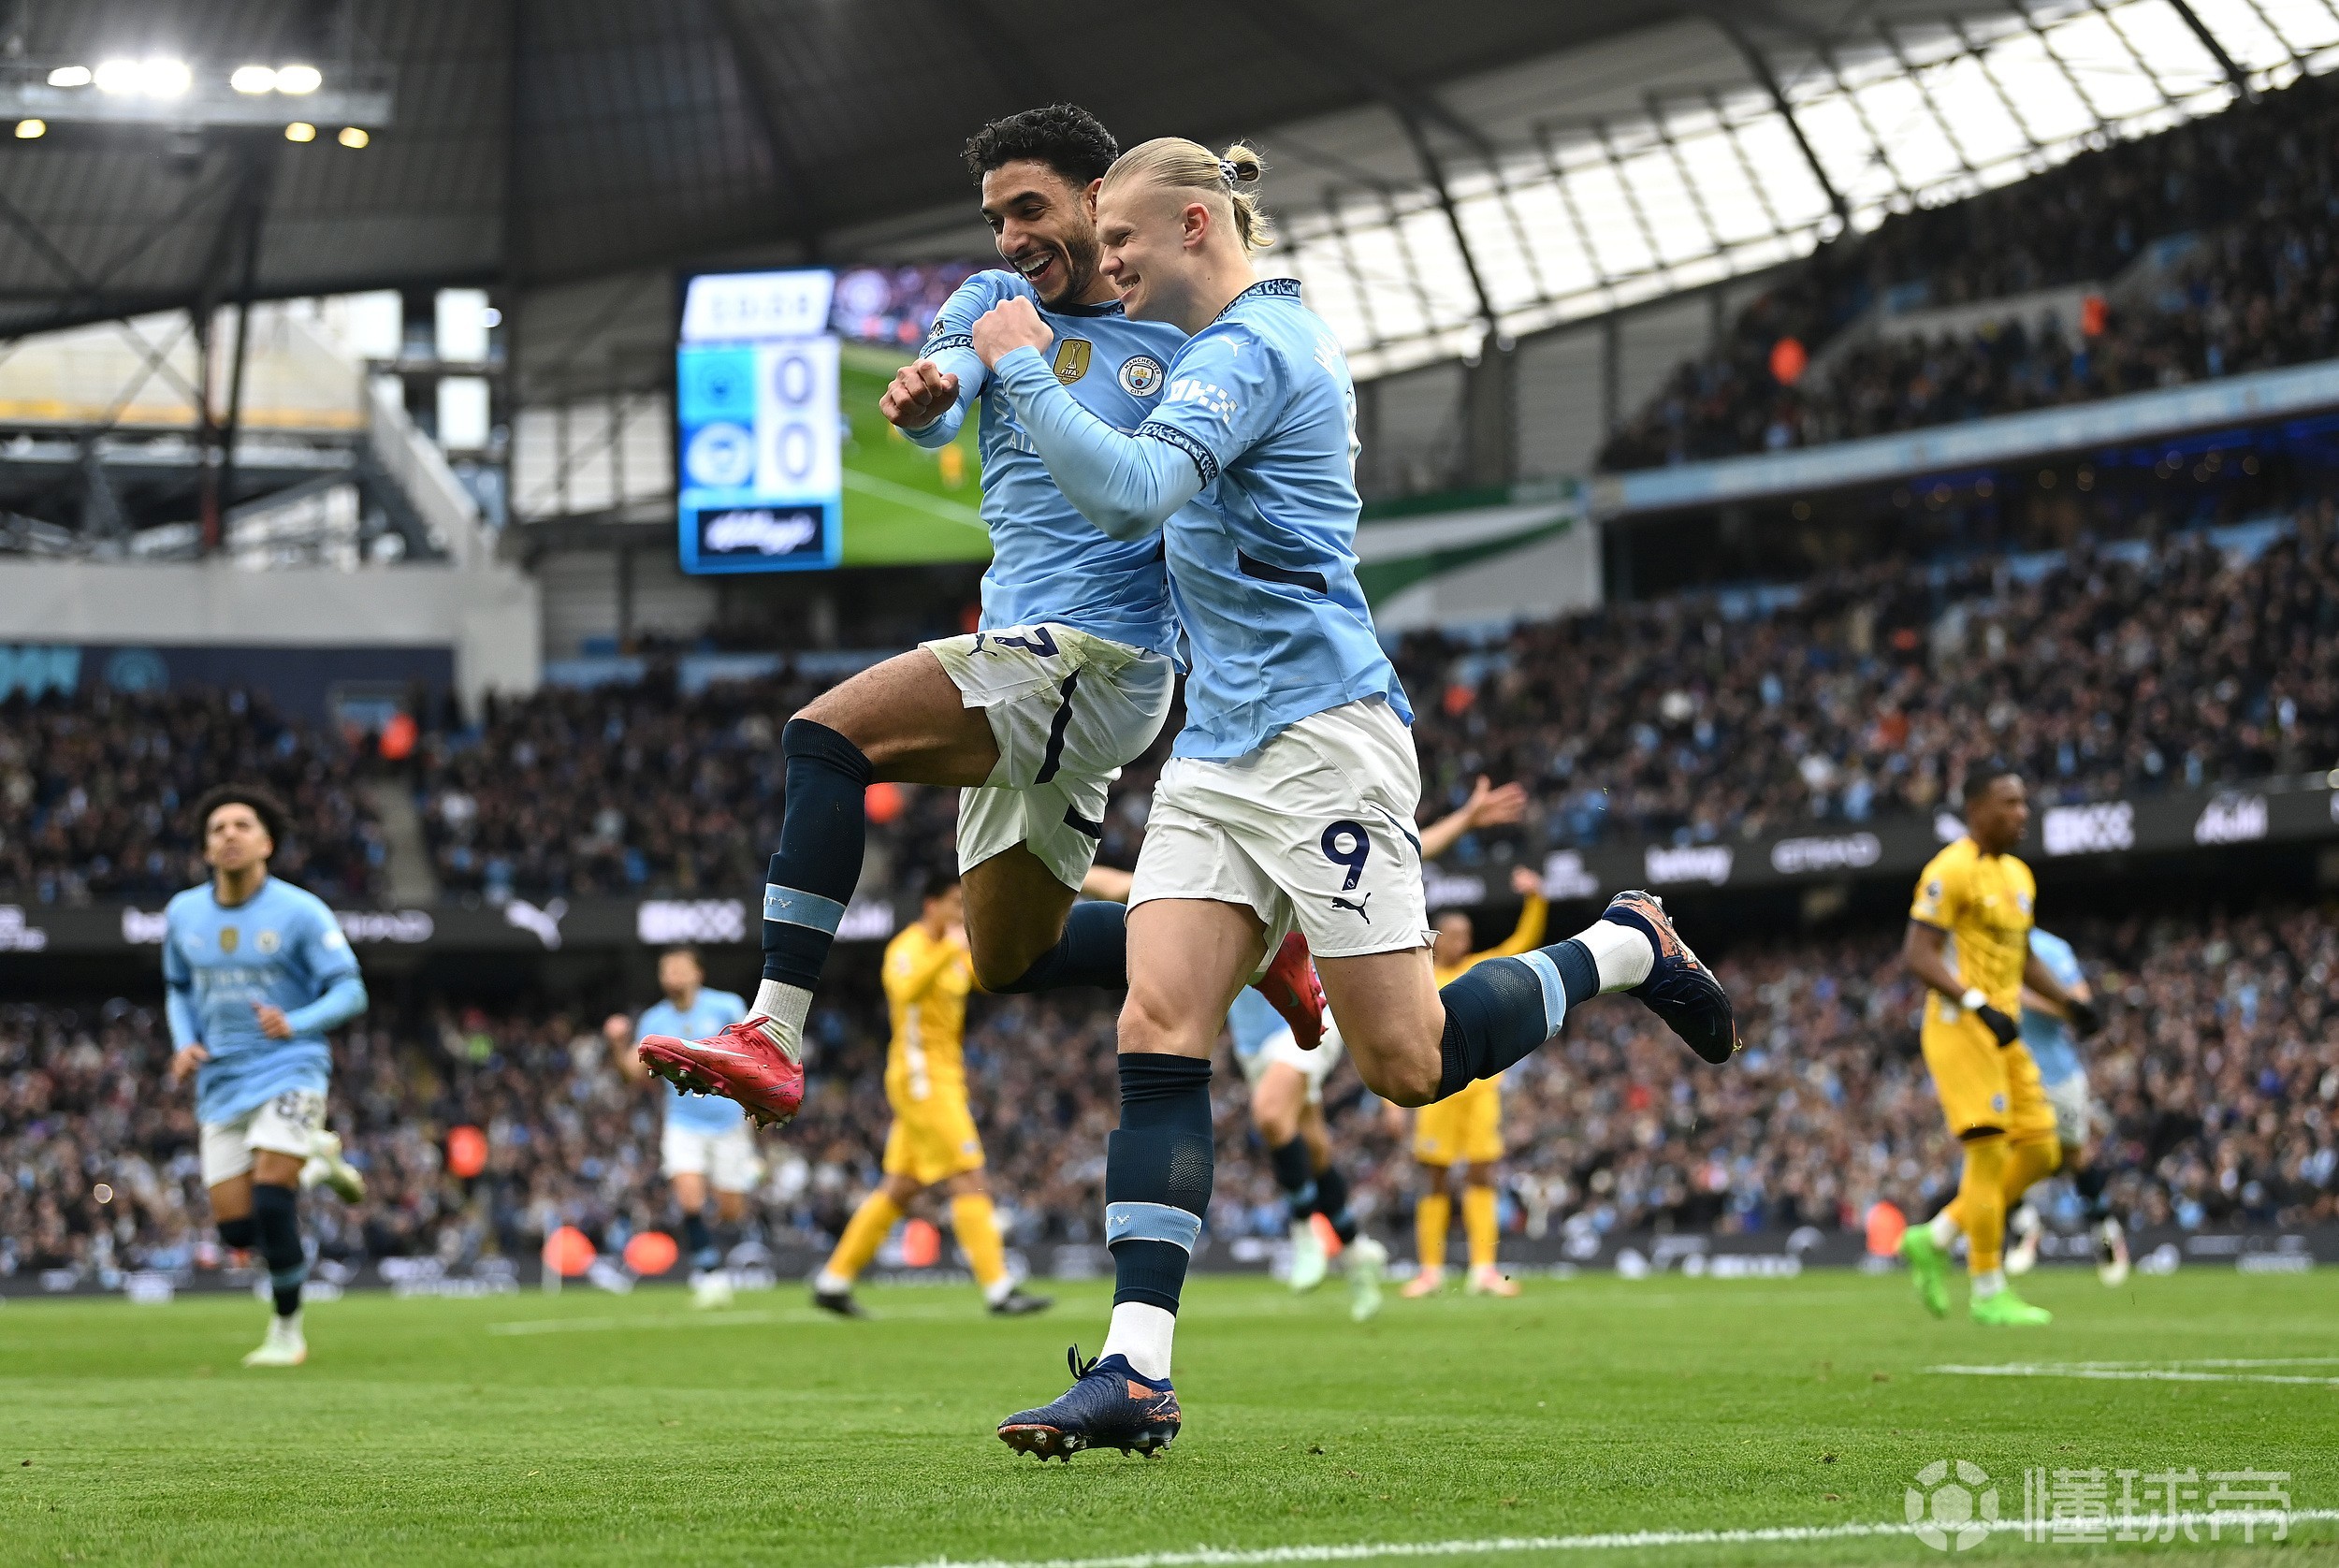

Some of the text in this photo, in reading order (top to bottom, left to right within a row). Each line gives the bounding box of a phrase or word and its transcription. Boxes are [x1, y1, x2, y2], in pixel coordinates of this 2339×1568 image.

[775, 351, 815, 410] 0
[1124, 357, 1161, 375] MANCHESTER
[775, 422, 815, 484] 0
[993, 627, 1060, 658] 7
[1320, 820, 1371, 892] 9
